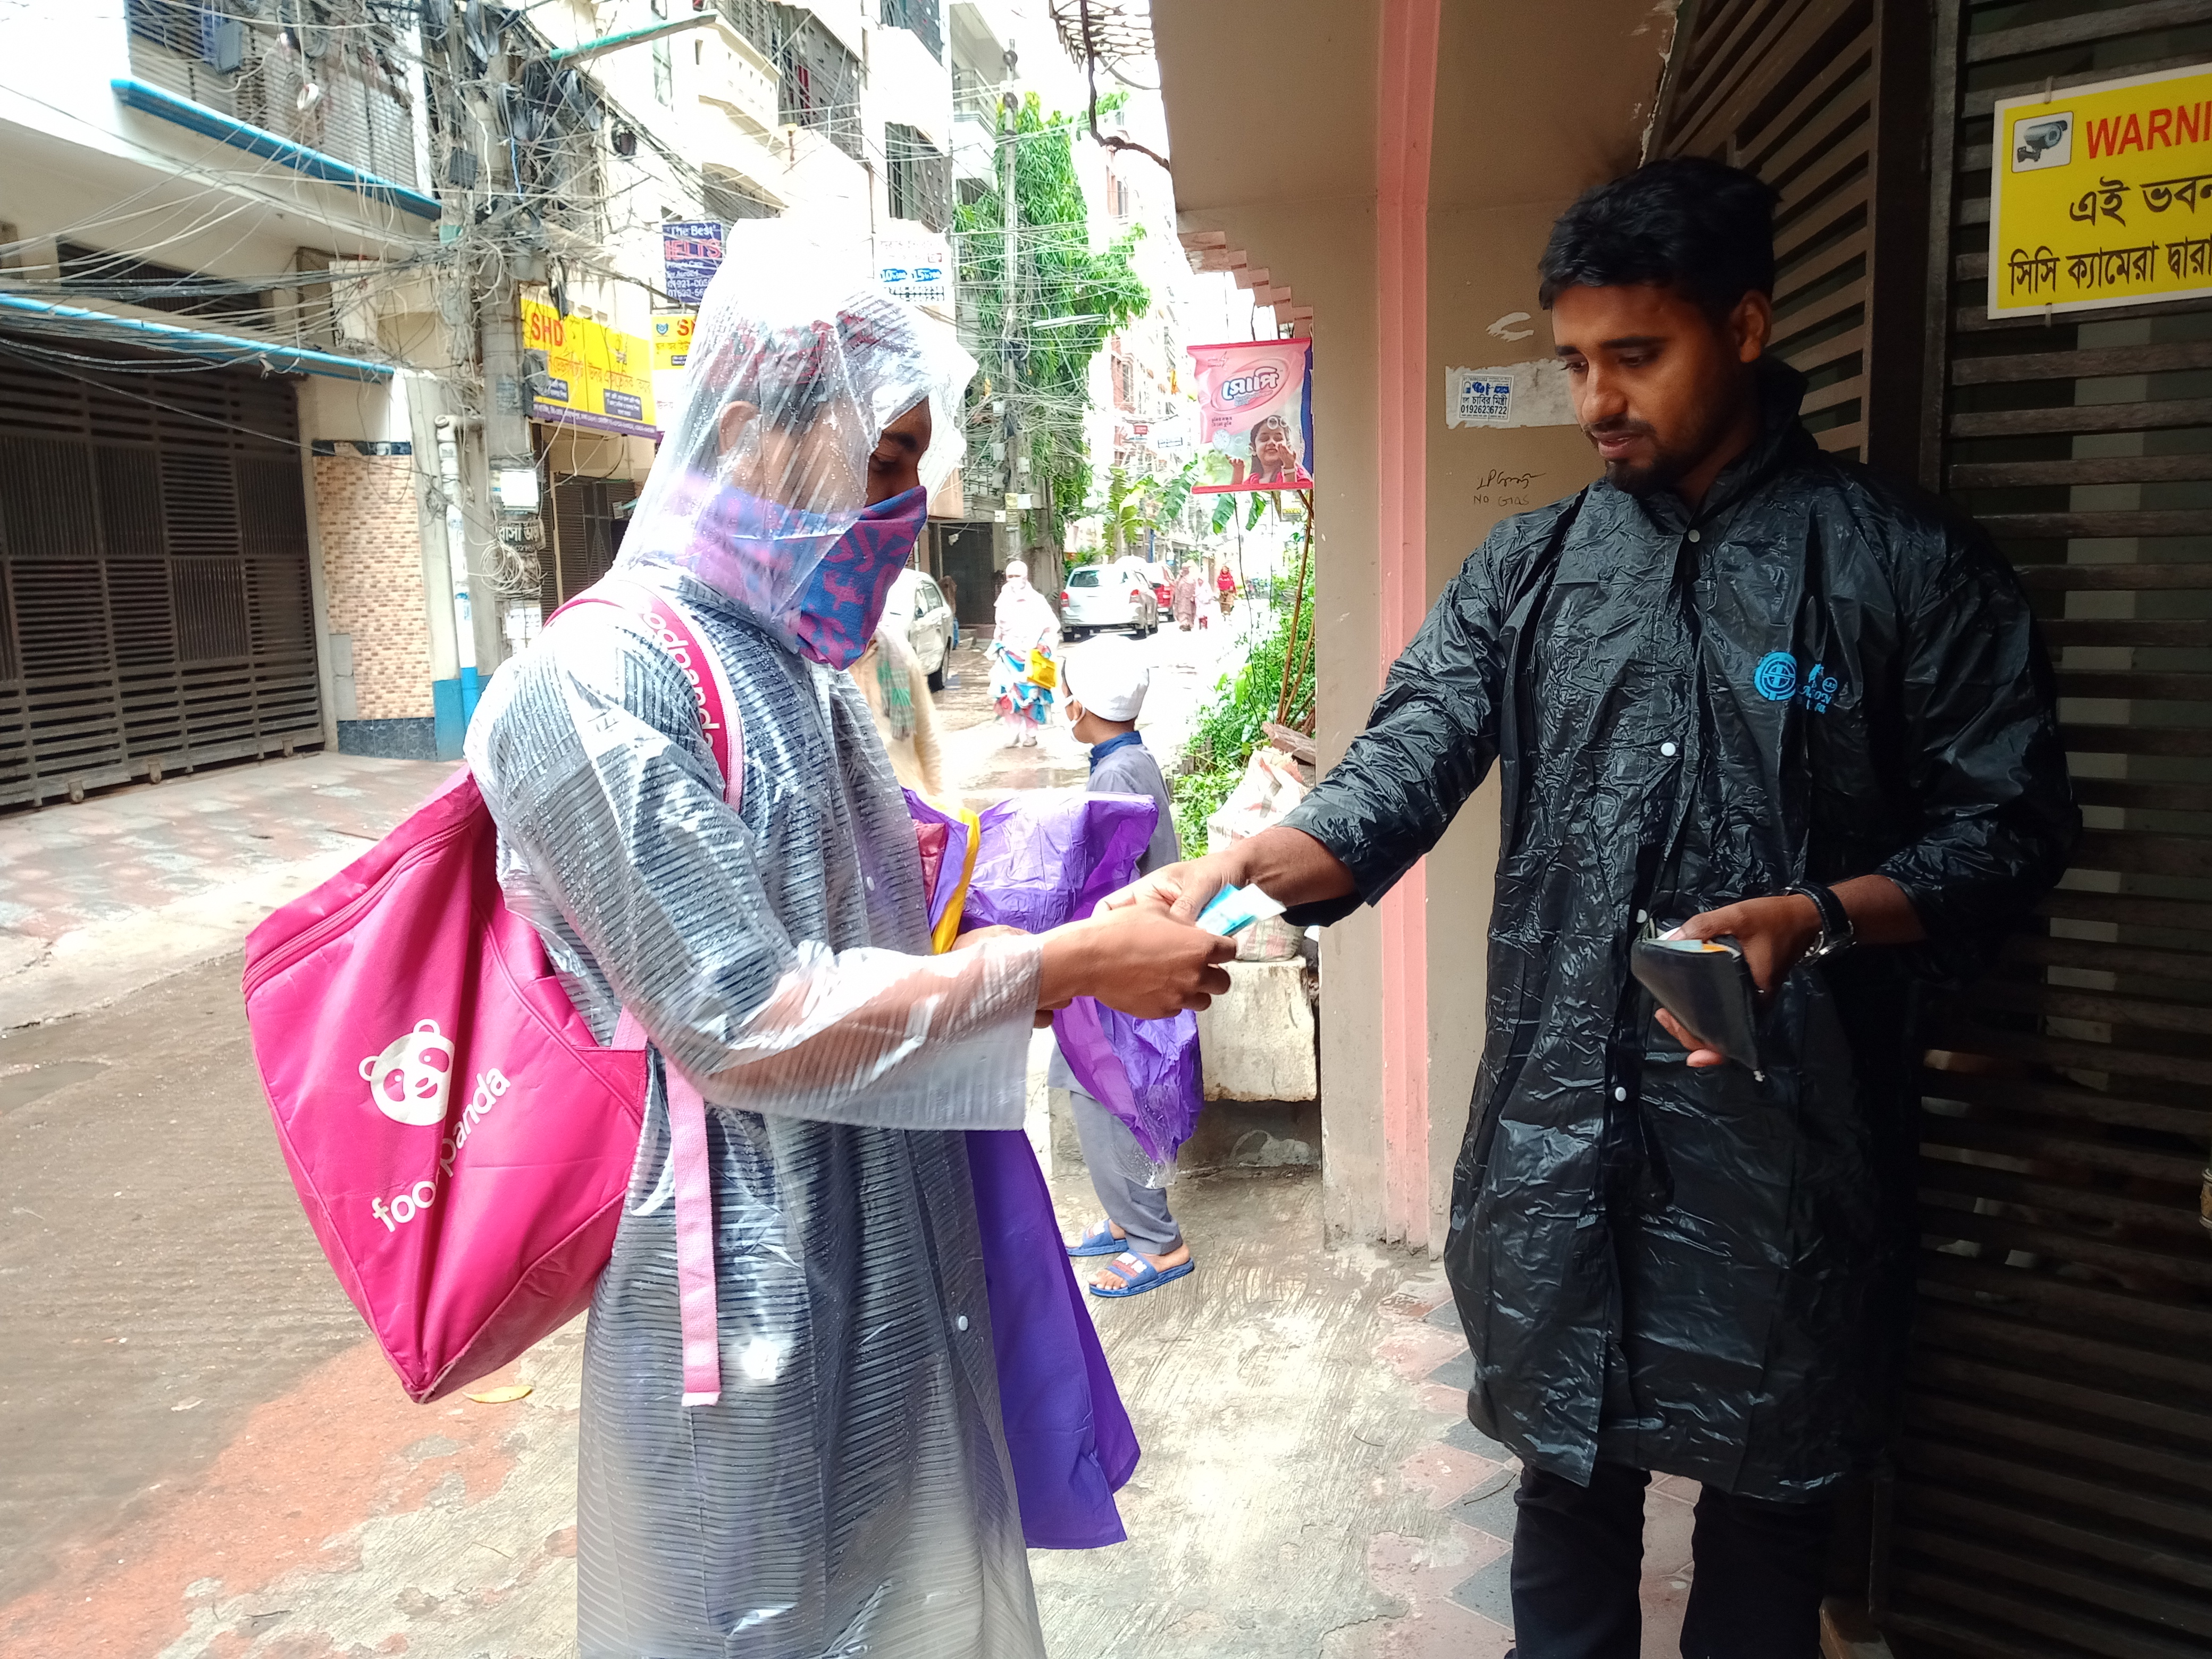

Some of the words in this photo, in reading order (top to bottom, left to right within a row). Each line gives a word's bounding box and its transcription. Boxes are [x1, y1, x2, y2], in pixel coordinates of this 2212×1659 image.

[2069, 177, 2130, 227] এই
[664, 238, 722, 261] IELTS
[2008, 245, 2060, 296] সিসি
[2066, 240, 2159, 290] ক্যামেরা
[531, 313, 564, 346] SHD
[1461, 405, 1507, 415] 01926236722
[1472, 394, 1491, 405] চাবির
[1474, 494, 1489, 504] NO
